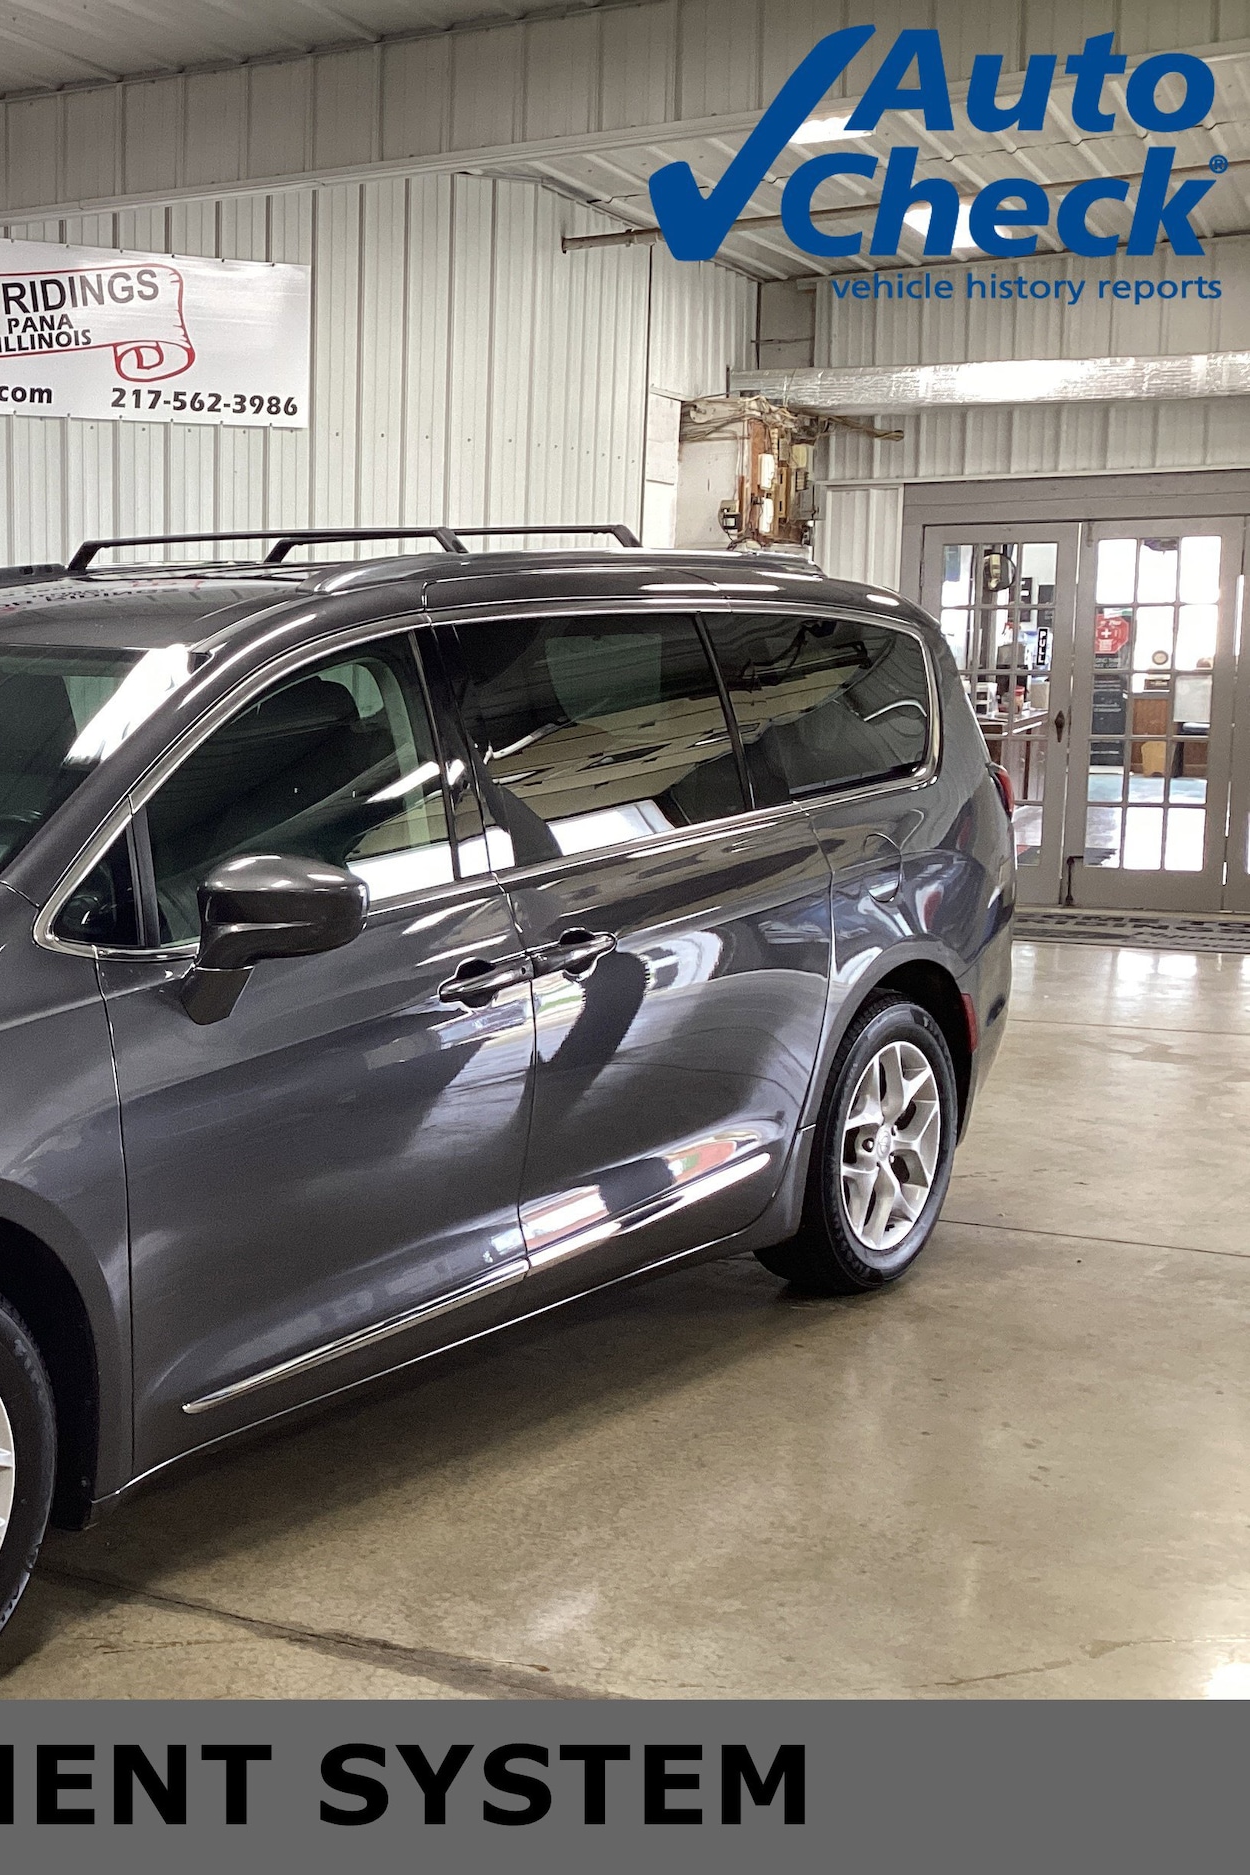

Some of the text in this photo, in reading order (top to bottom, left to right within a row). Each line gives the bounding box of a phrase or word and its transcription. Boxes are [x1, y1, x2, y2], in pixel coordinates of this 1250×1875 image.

[2, 269, 160, 317] RIDINGS
[6, 314, 74, 334] PANA
[111, 387, 298, 416] 217-562-3986
[1037, 630, 1047, 663] PULL
